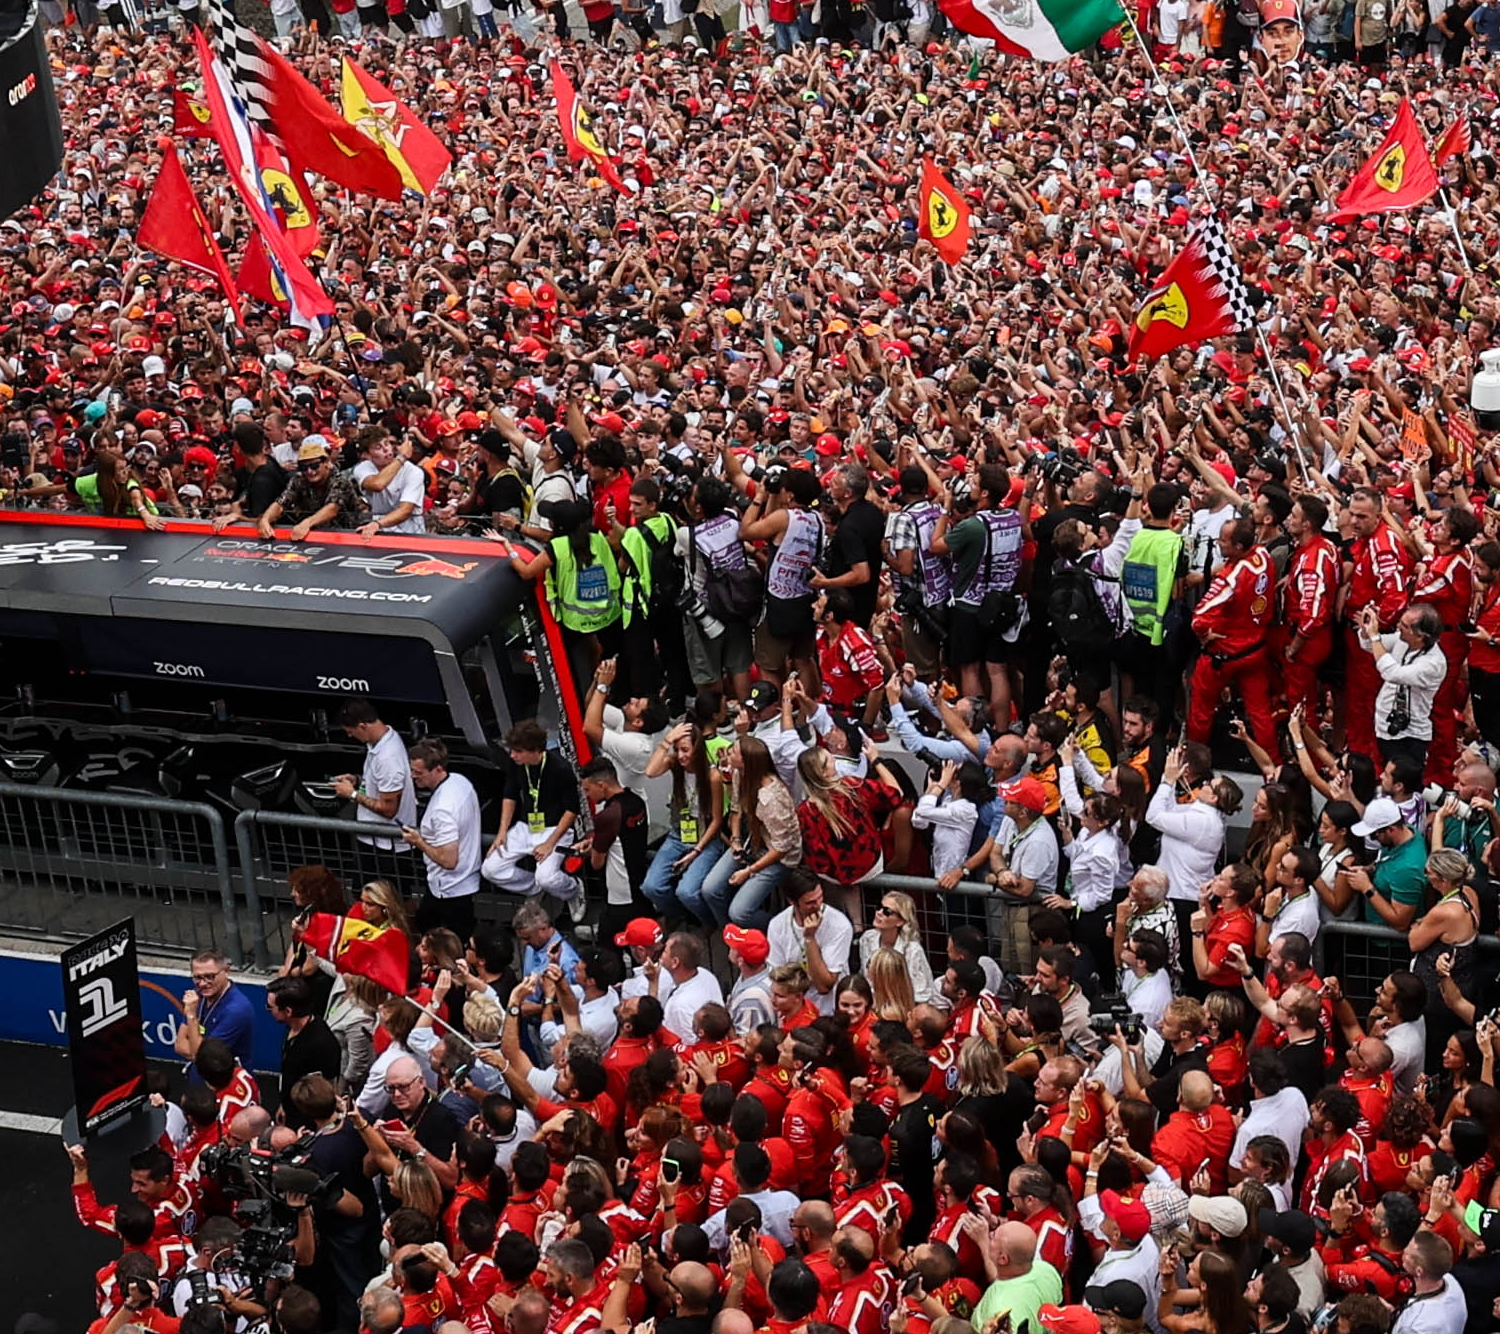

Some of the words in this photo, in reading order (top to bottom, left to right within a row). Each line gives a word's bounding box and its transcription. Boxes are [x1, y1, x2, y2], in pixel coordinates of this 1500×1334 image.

[216, 539, 324, 555] ORACLE
[148, 575, 433, 604] REDBULLRACING.COM
[153, 661, 205, 677] zoom
[316, 676, 370, 692] zoom
[68, 939, 129, 983] ITALY
